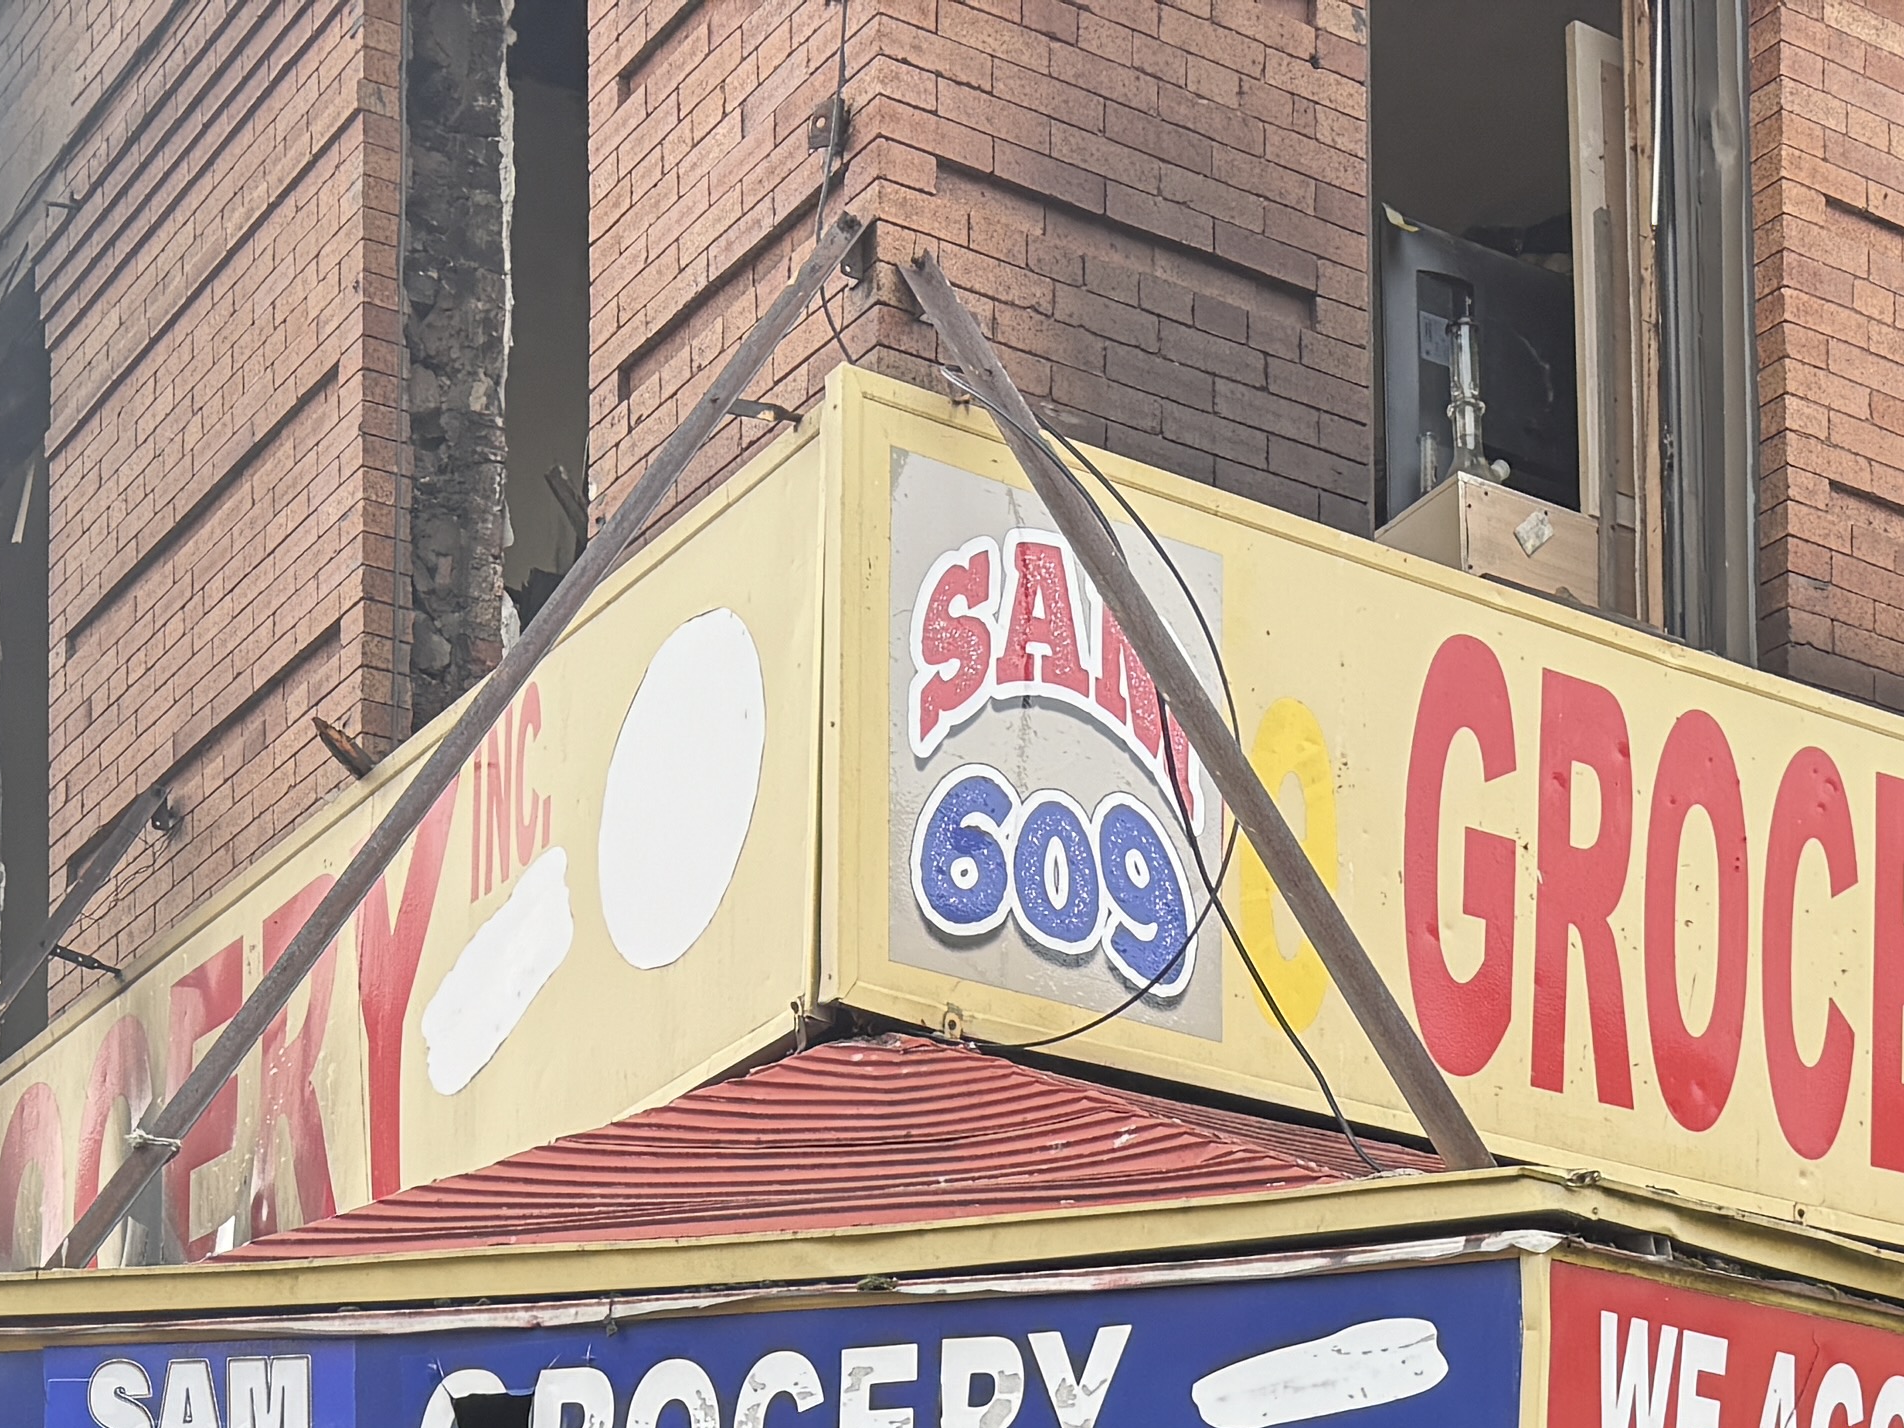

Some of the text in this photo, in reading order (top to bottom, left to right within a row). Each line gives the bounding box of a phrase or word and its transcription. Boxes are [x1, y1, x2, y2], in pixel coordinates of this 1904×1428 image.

[469, 681, 553, 906] INC.
[911, 530, 1202, 834] SAM
[911, 763, 1199, 996] 609
